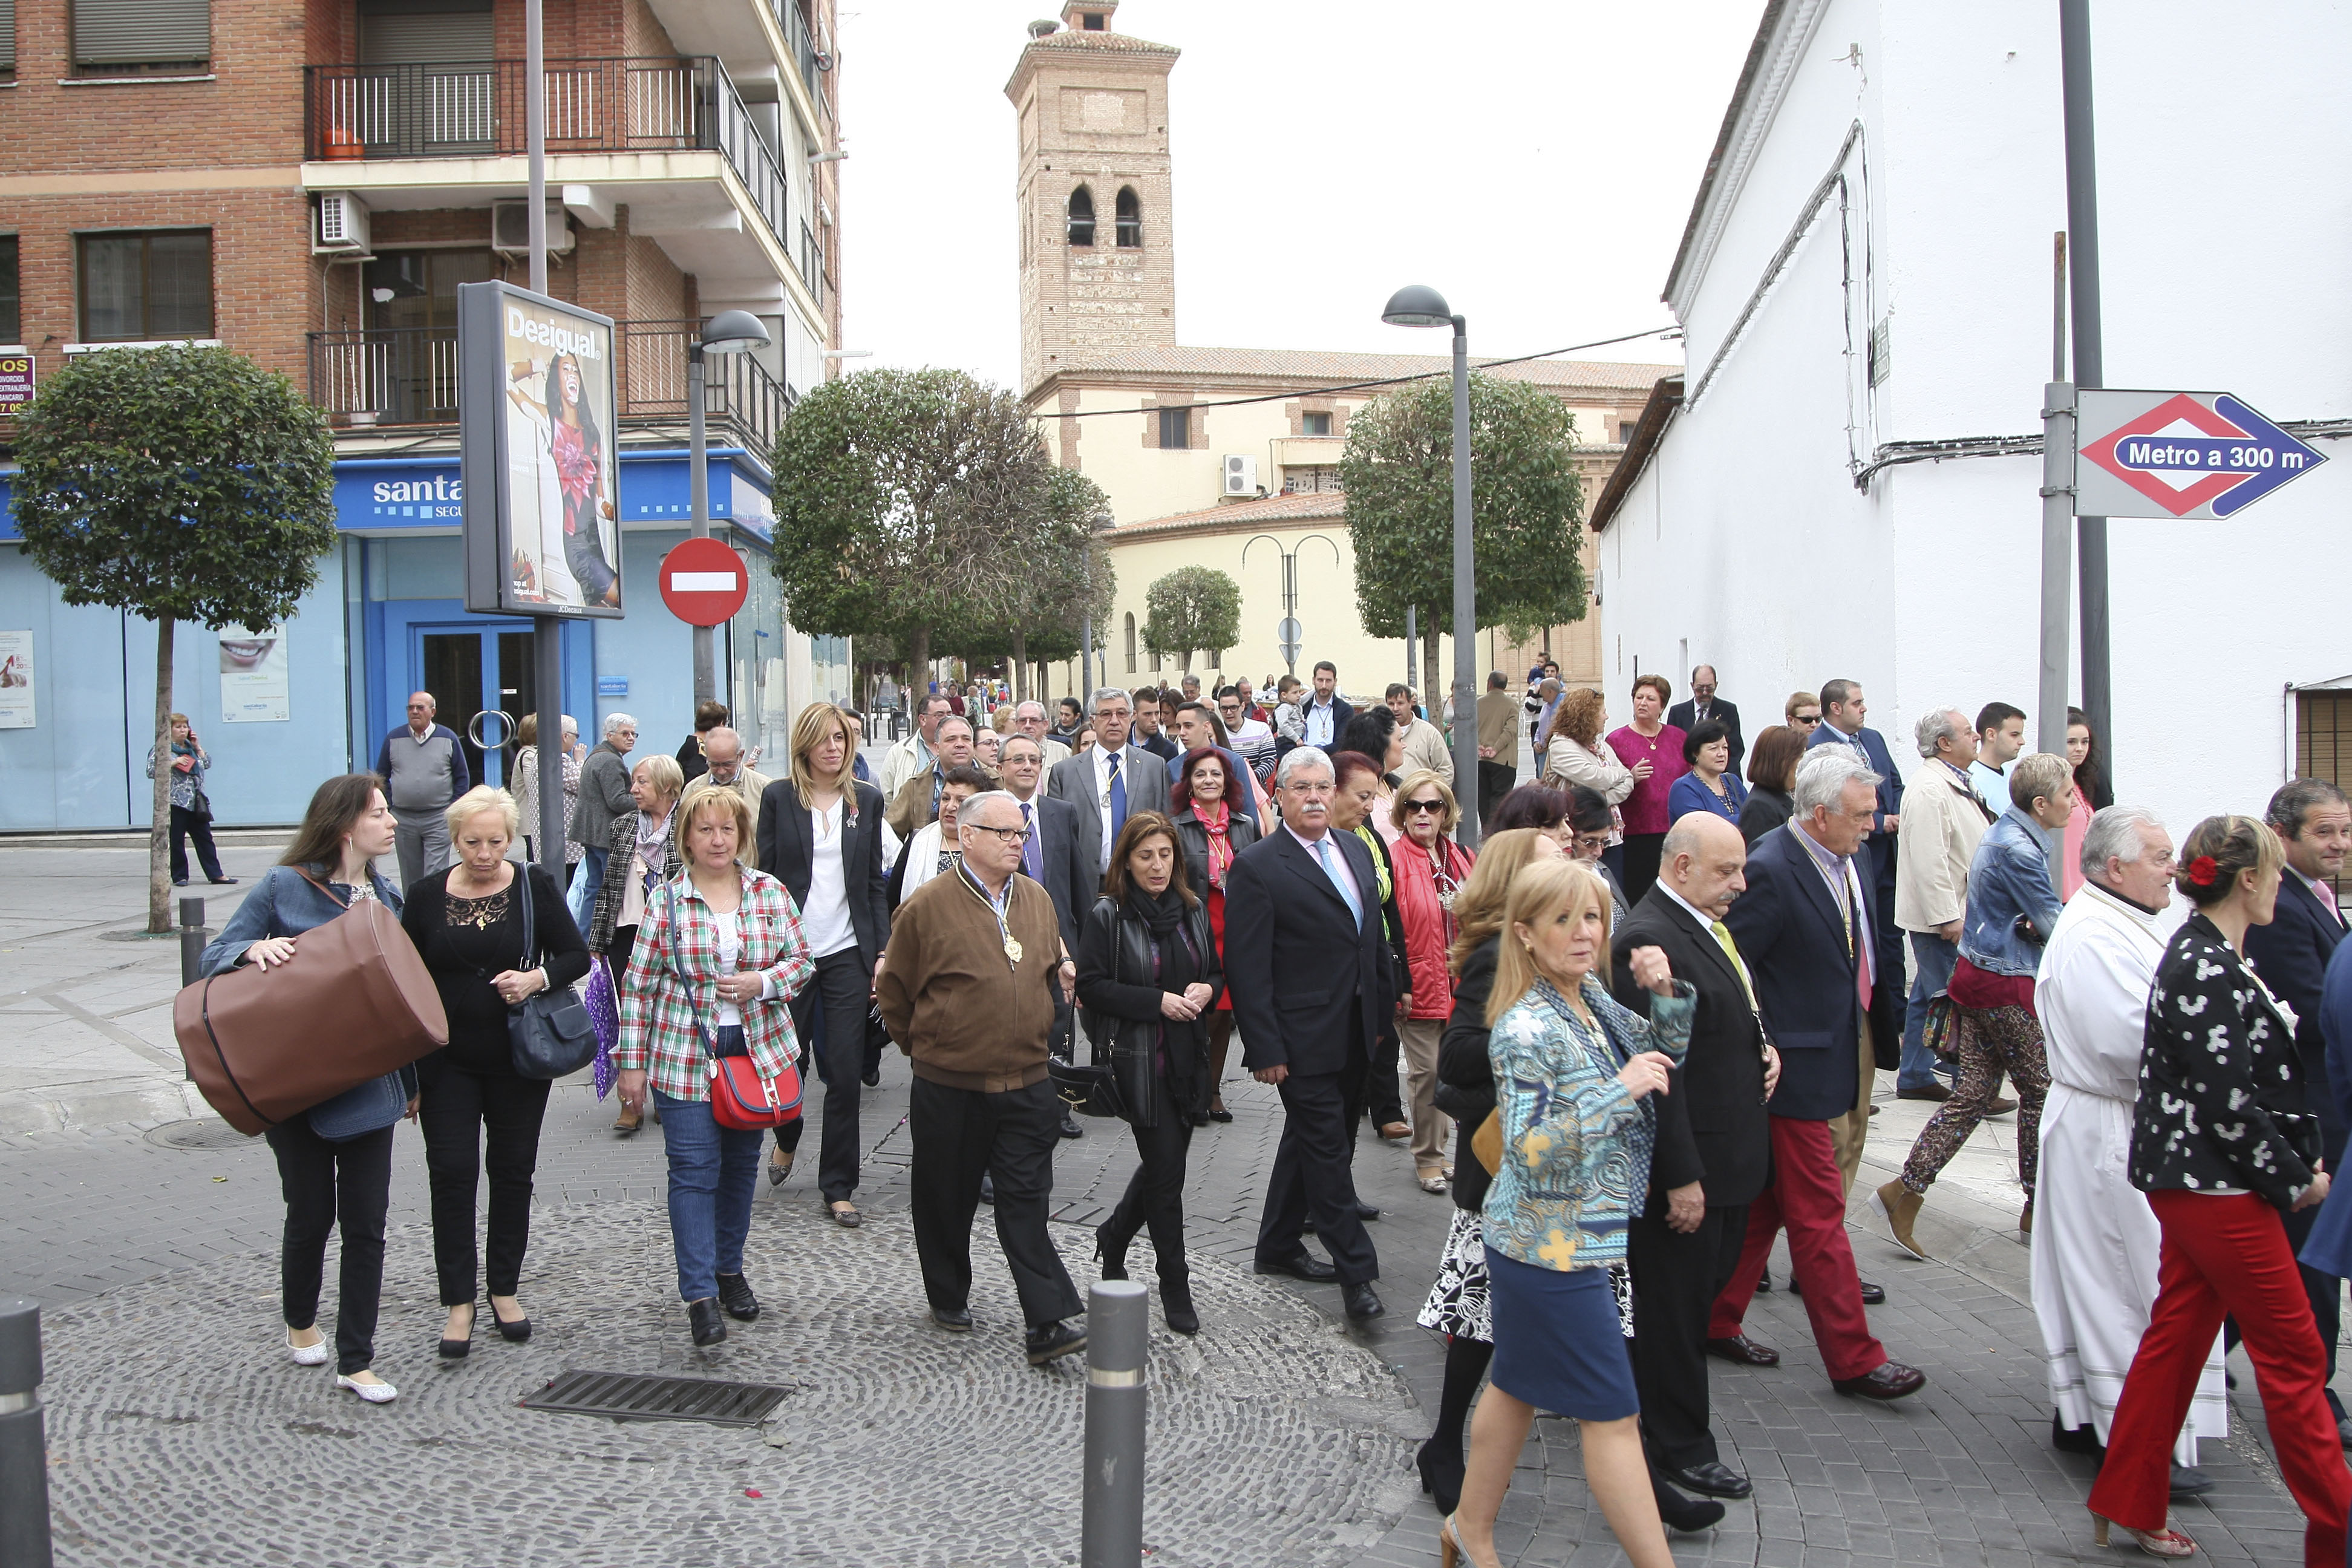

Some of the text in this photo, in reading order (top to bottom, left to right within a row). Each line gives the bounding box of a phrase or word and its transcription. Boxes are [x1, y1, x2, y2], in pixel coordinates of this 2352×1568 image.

[0, 359, 28, 373] OS
[2129, 442, 2303, 469] Metro a 300 m
[558, 606, 583, 614] JCDecaux
